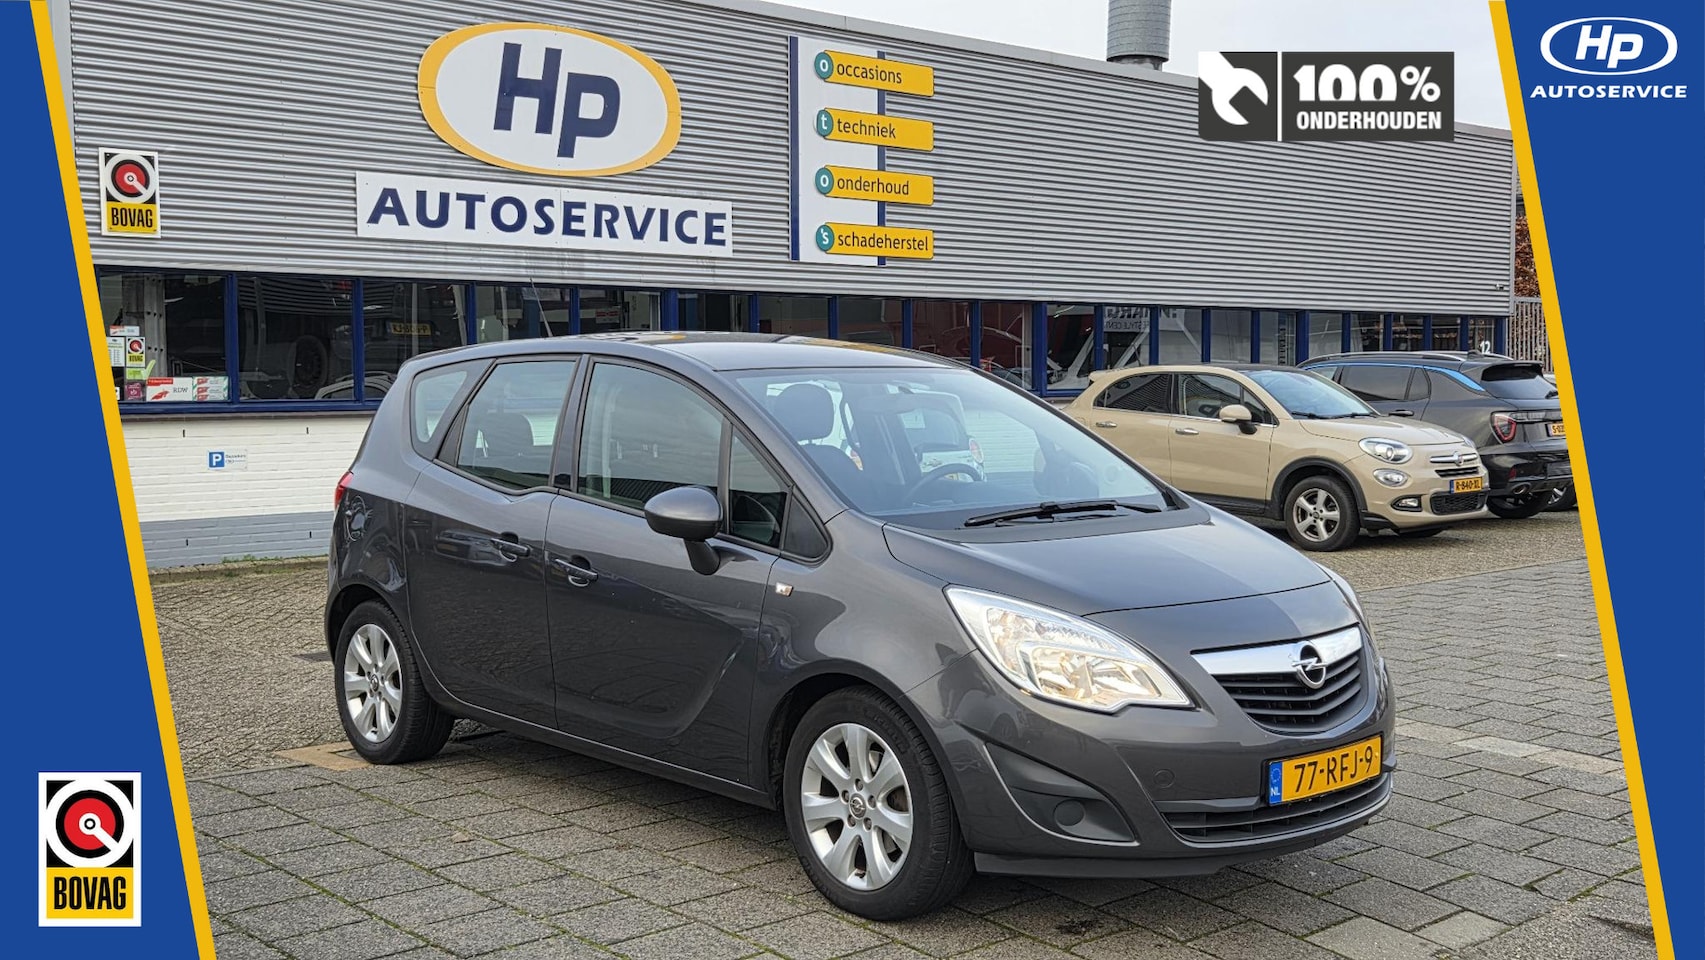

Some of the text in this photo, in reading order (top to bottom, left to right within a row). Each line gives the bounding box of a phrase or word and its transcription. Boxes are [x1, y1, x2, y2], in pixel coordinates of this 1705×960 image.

[837, 62, 902, 84] occasions
[837, 117, 896, 139] techniek
[837, 176, 910, 196] onderhoud
[111, 207, 153, 228] BOVAG
[366, 187, 727, 247] AUTOSERVICE
[838, 231, 929, 251] schadeherstel
[1480, 341, 1491, 354] 12
[212, 453, 222, 466] P
[1294, 746, 1373, 792] 77-RFJ-9
[1270, 788, 1280, 796] NL
